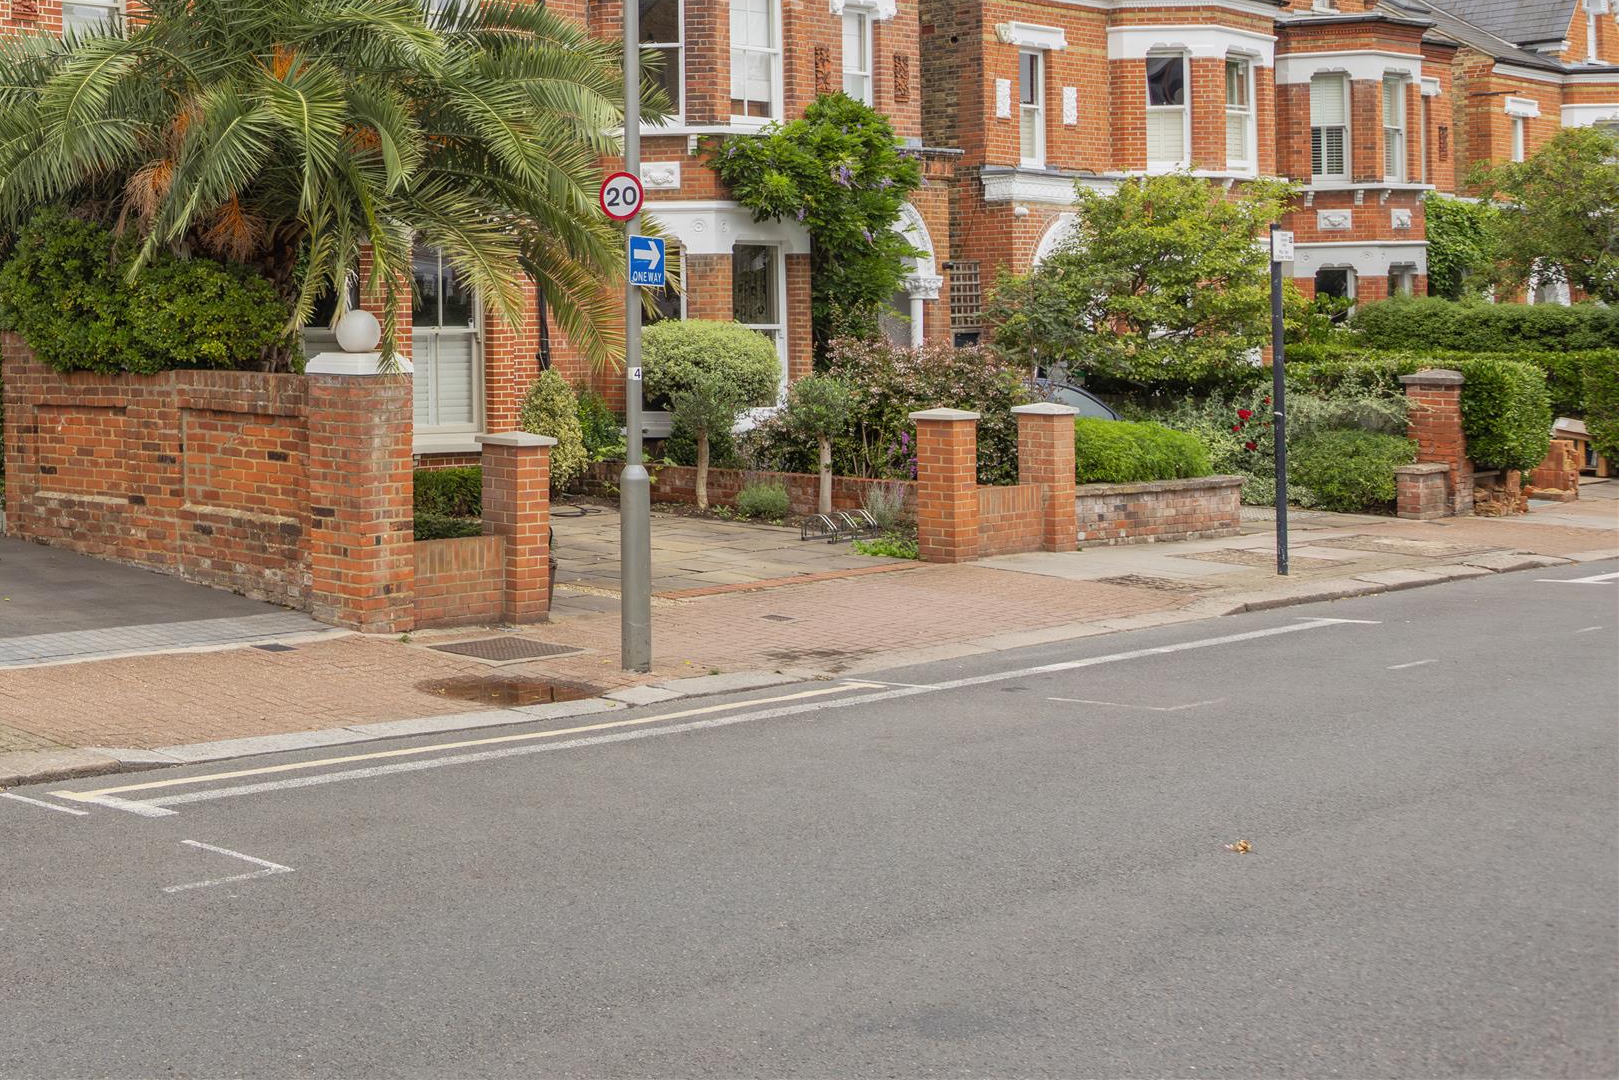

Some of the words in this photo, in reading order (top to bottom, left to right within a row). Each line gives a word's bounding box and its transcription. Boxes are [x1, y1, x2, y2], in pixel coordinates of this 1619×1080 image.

[606, 186, 637, 207] 20
[632, 270, 648, 282] ONE
[647, 271, 662, 283] WAY
[634, 368, 641, 379] 4
